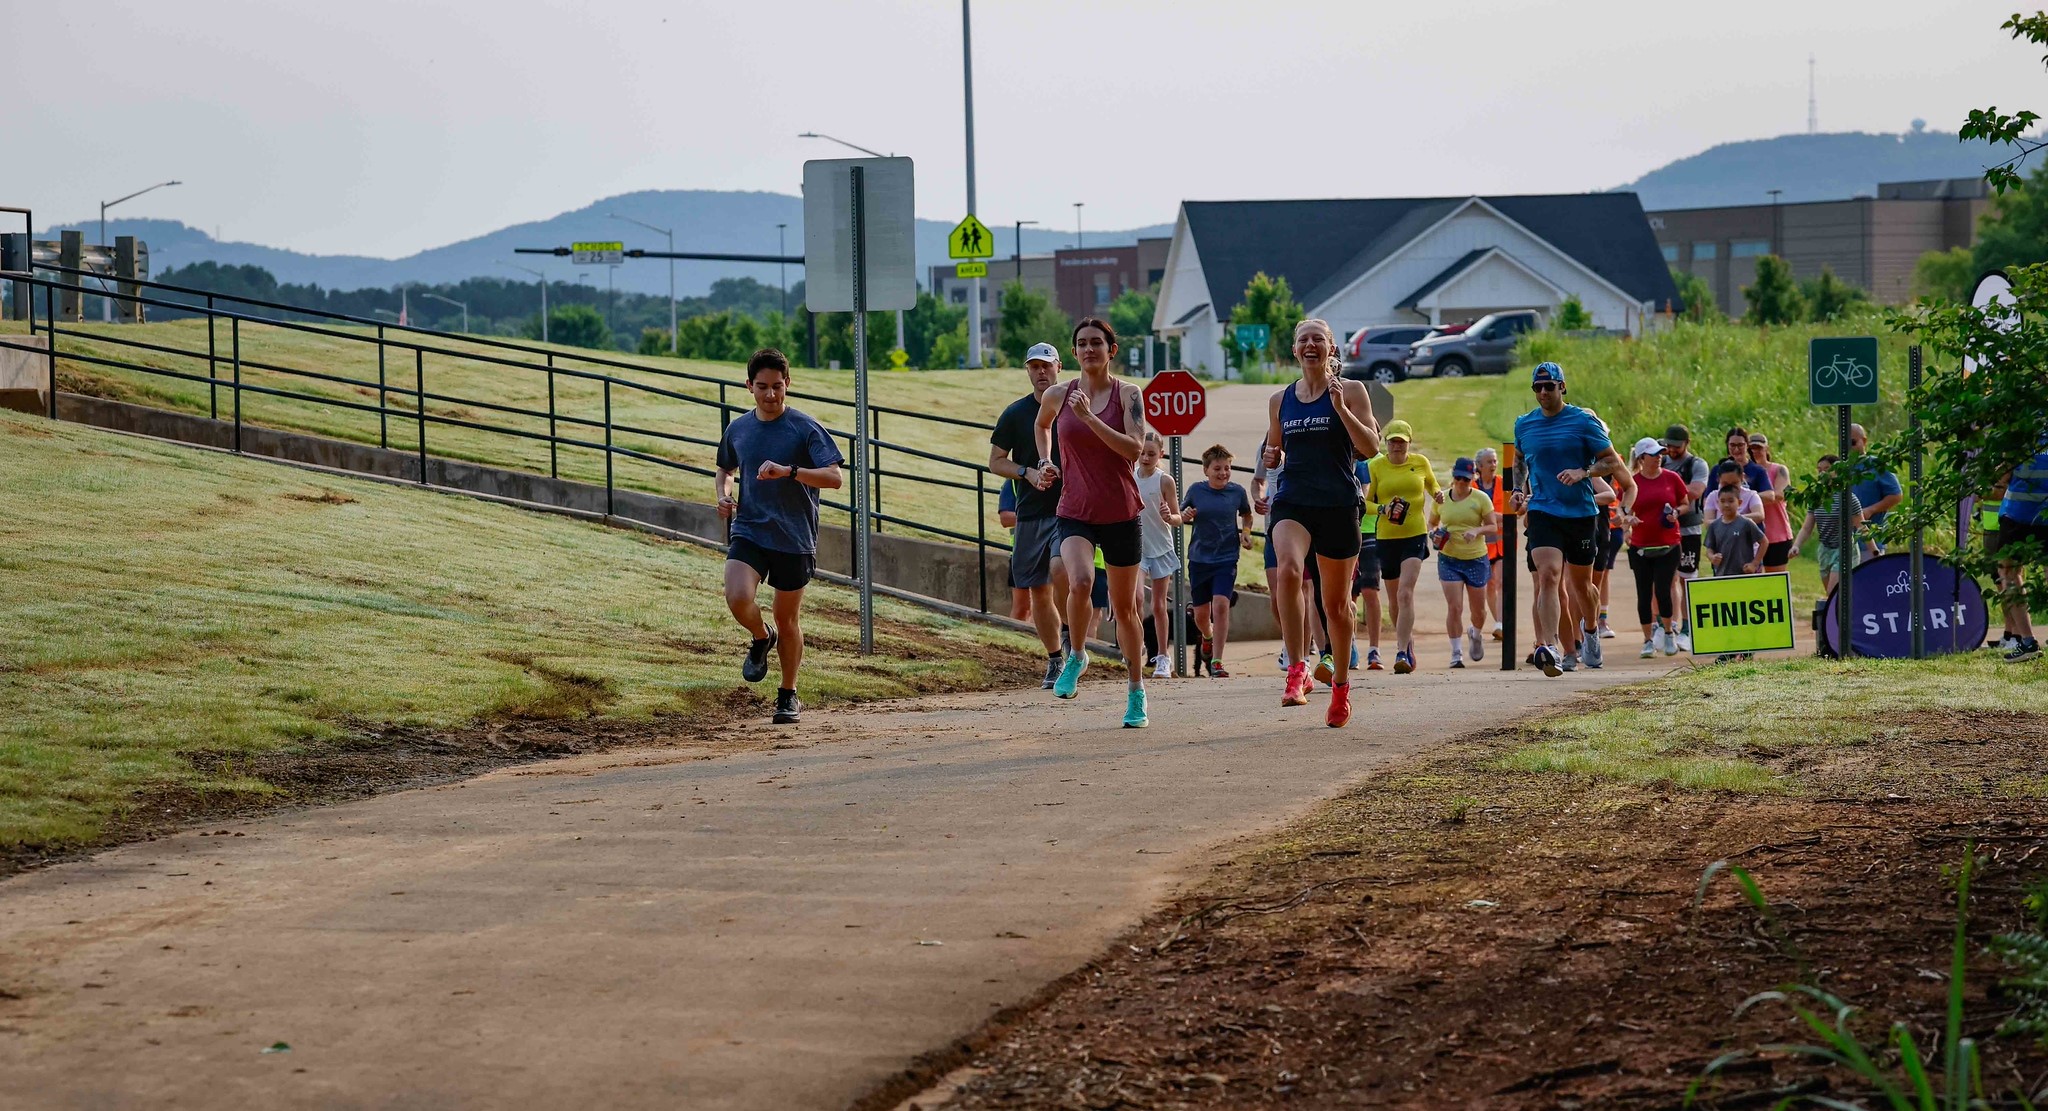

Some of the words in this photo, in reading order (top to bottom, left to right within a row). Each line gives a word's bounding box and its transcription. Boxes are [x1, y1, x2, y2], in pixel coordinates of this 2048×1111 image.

[578, 242, 617, 251] SCHOOL
[590, 251, 604, 263] 25
[960, 265, 983, 273] AHEAD
[1148, 390, 1202, 417] STOP
[1311, 416, 1331, 424] FEET
[1886, 577, 1930, 597] parkn
[1695, 598, 1785, 629] FINISH
[1862, 604, 1967, 635] STRT
